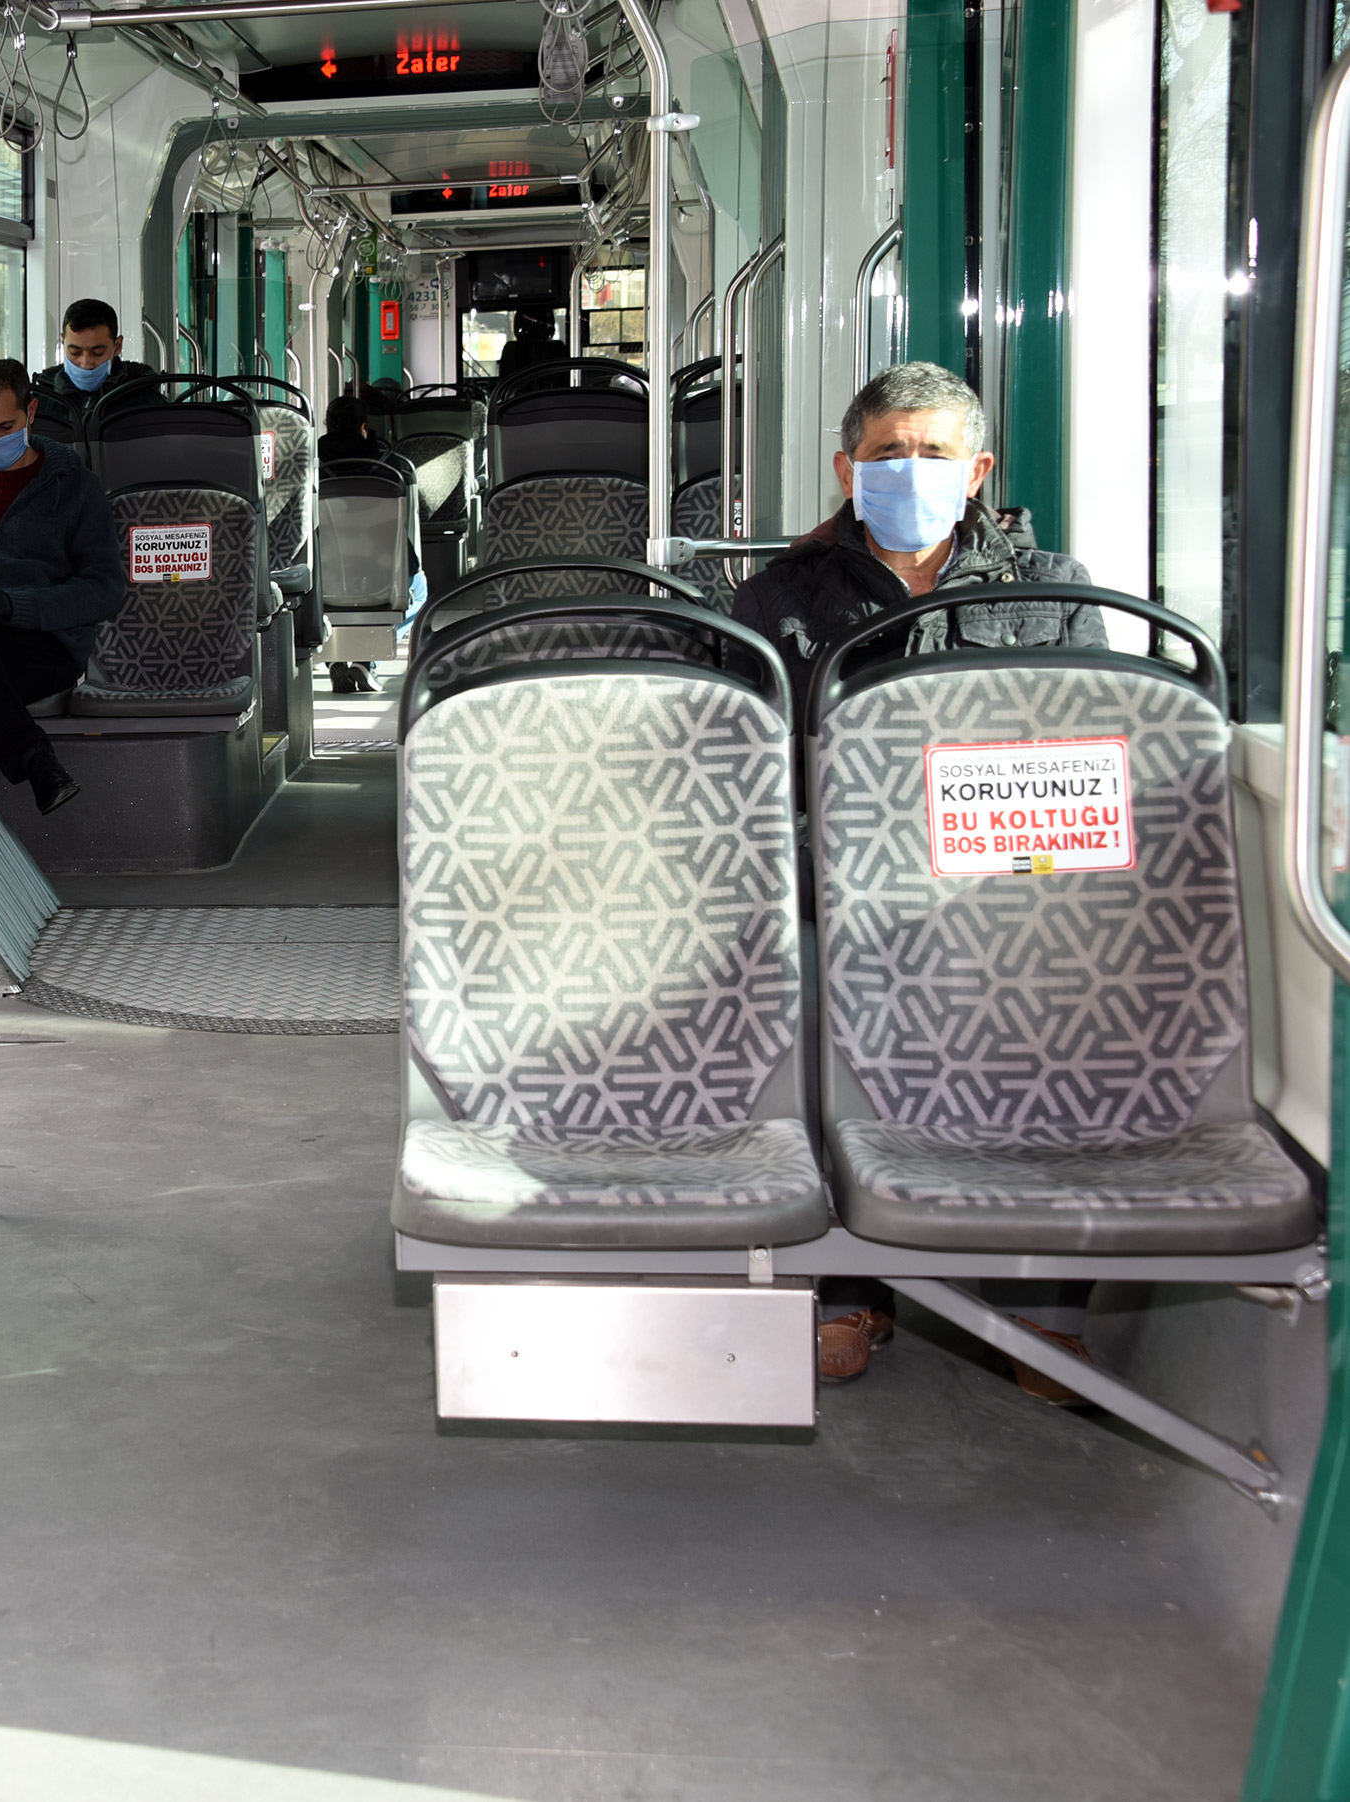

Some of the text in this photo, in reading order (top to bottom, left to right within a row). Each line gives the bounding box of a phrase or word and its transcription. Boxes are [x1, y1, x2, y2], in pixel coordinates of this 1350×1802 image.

[396, 51, 460, 75] Zafer
[488, 184, 530, 198] Zafer
[135, 533, 163, 541] SOSYAL
[135, 541, 201, 551] KORUYUNUZ
[135, 552, 207, 563] BU KOLTUĞU
[135, 565, 153, 574] BOŞ
[156, 563, 201, 573] BIRAKINIZ
[939, 763, 1006, 778] SOSYAL
[940, 777, 1118, 801] KORUYUNUZ !
[943, 805, 1121, 831] BU KOLTUĞU
[943, 830, 1120, 854] BOŞ BIRAKINIZ !
